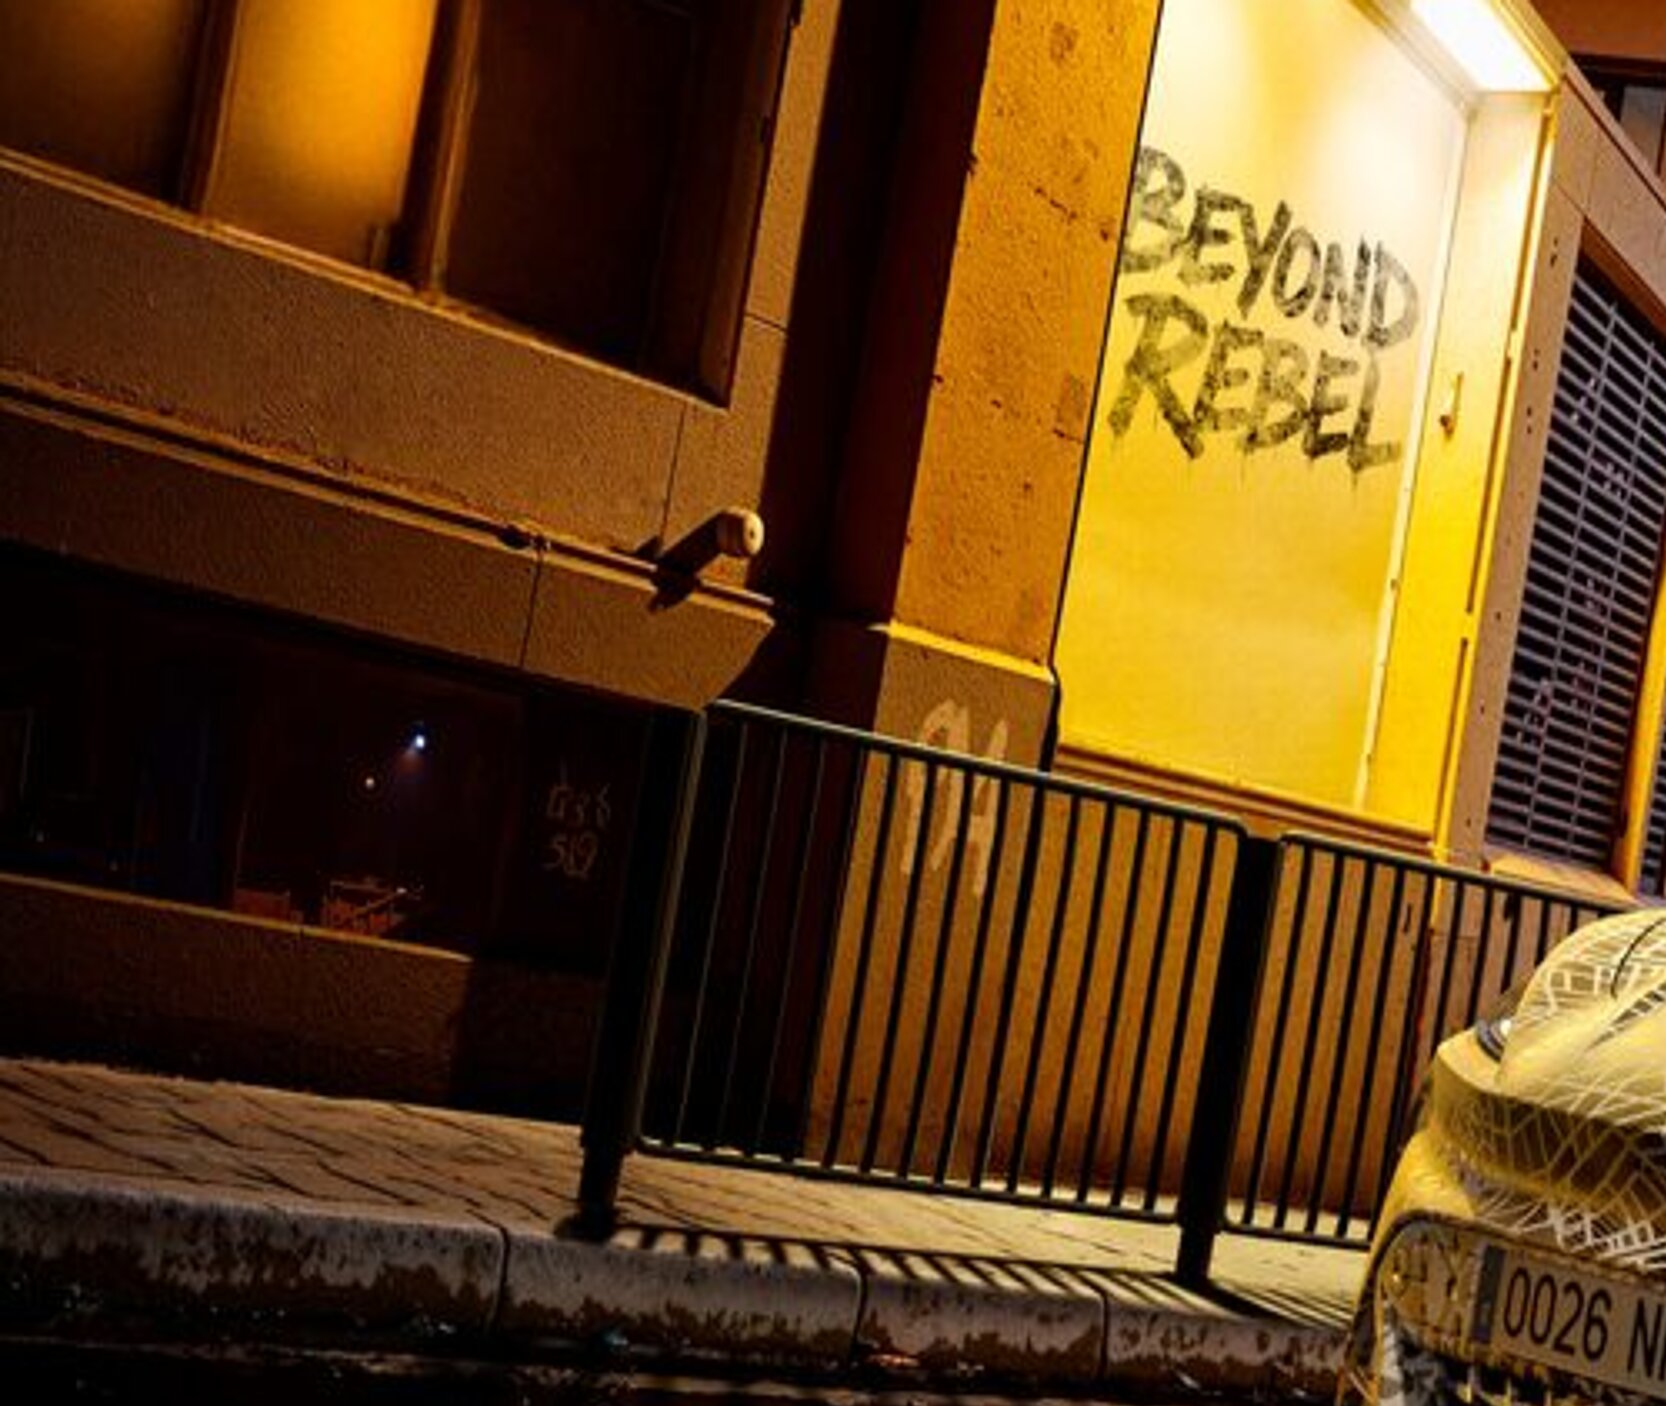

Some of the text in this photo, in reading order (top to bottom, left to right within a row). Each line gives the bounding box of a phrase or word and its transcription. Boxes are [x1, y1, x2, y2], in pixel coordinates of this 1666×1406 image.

[1117, 145, 1419, 348] BEYOND
[1108, 293, 1402, 475] REBEL
[1503, 1267, 1612, 1362] 0026
